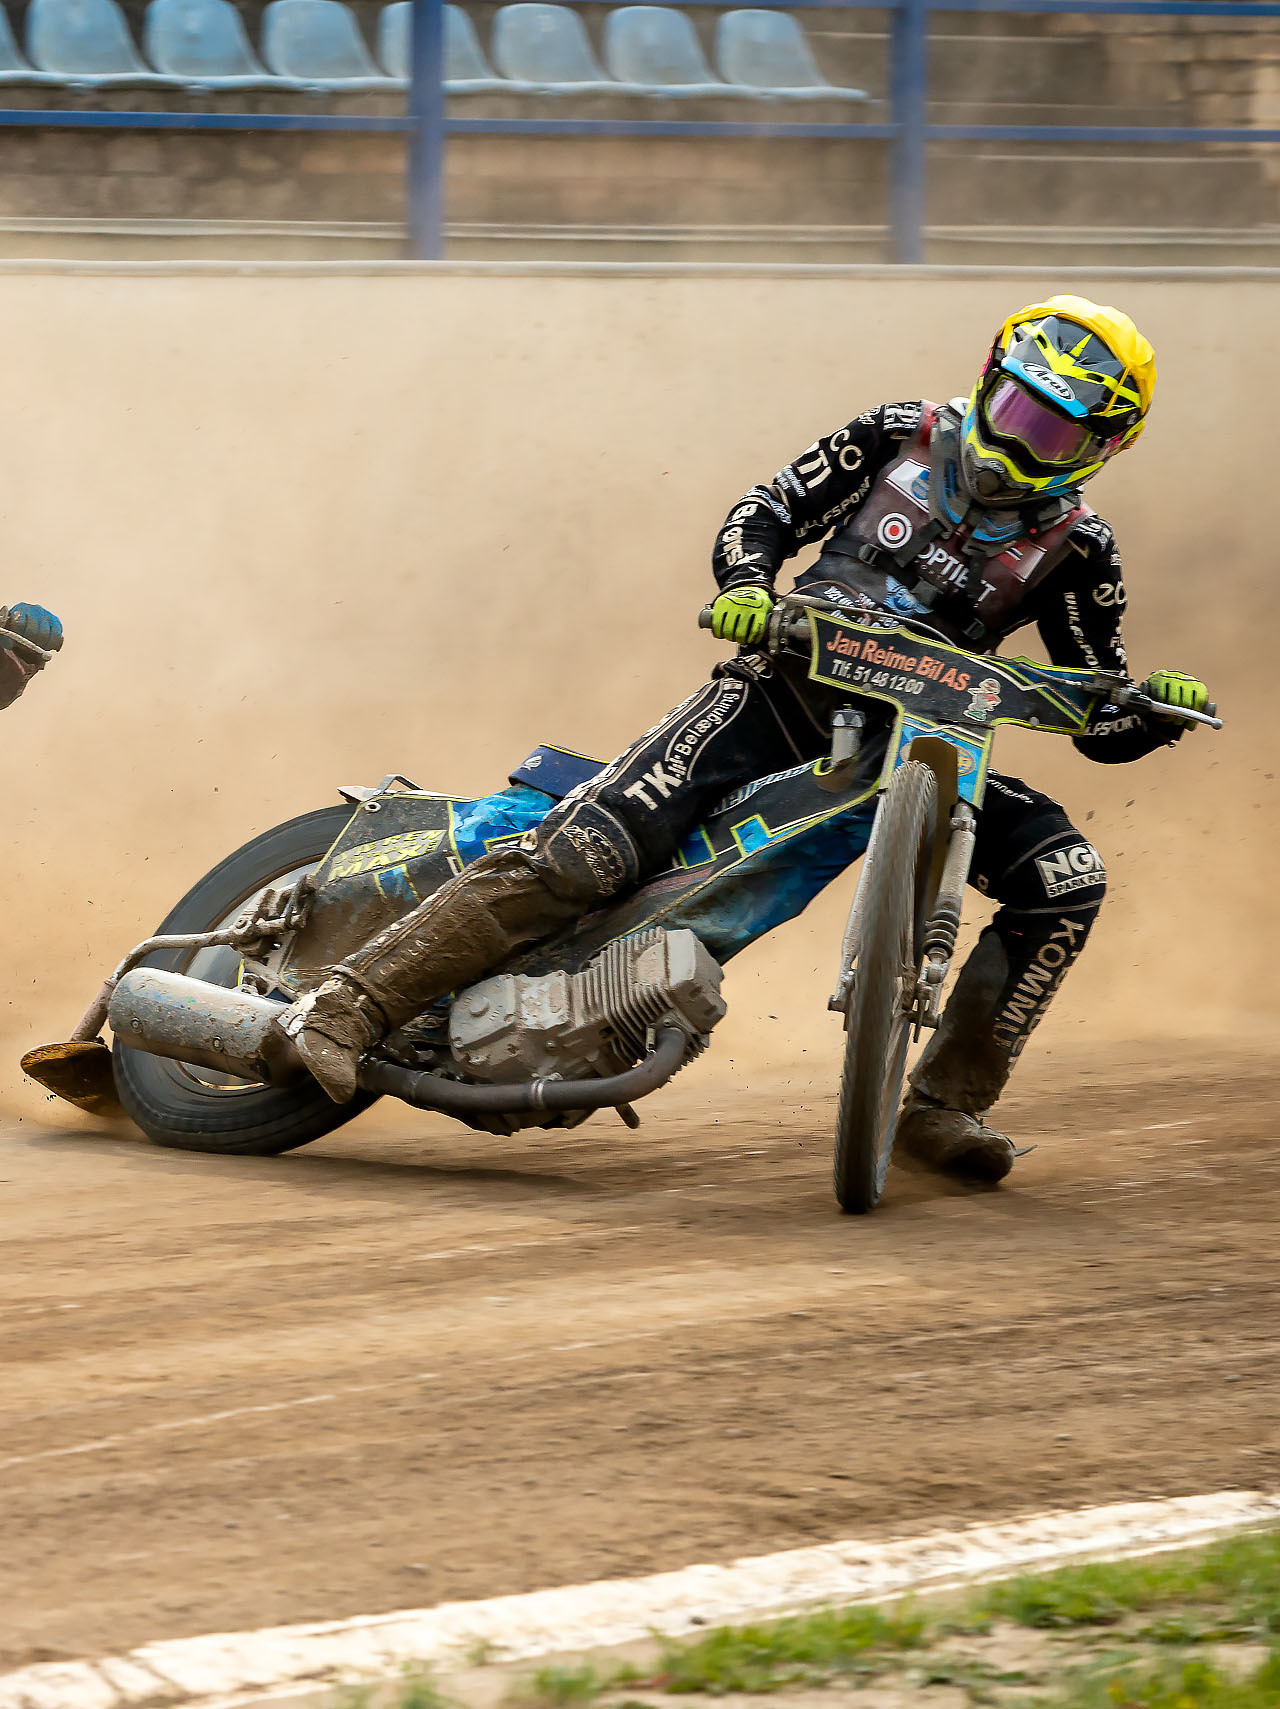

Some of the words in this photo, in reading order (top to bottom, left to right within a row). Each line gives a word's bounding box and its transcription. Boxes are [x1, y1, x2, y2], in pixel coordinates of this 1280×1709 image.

[826, 630, 861, 657] Jan
[860, 639, 917, 672] Reime
[916, 655, 945, 682] Bil
[939, 667, 971, 692] AS
